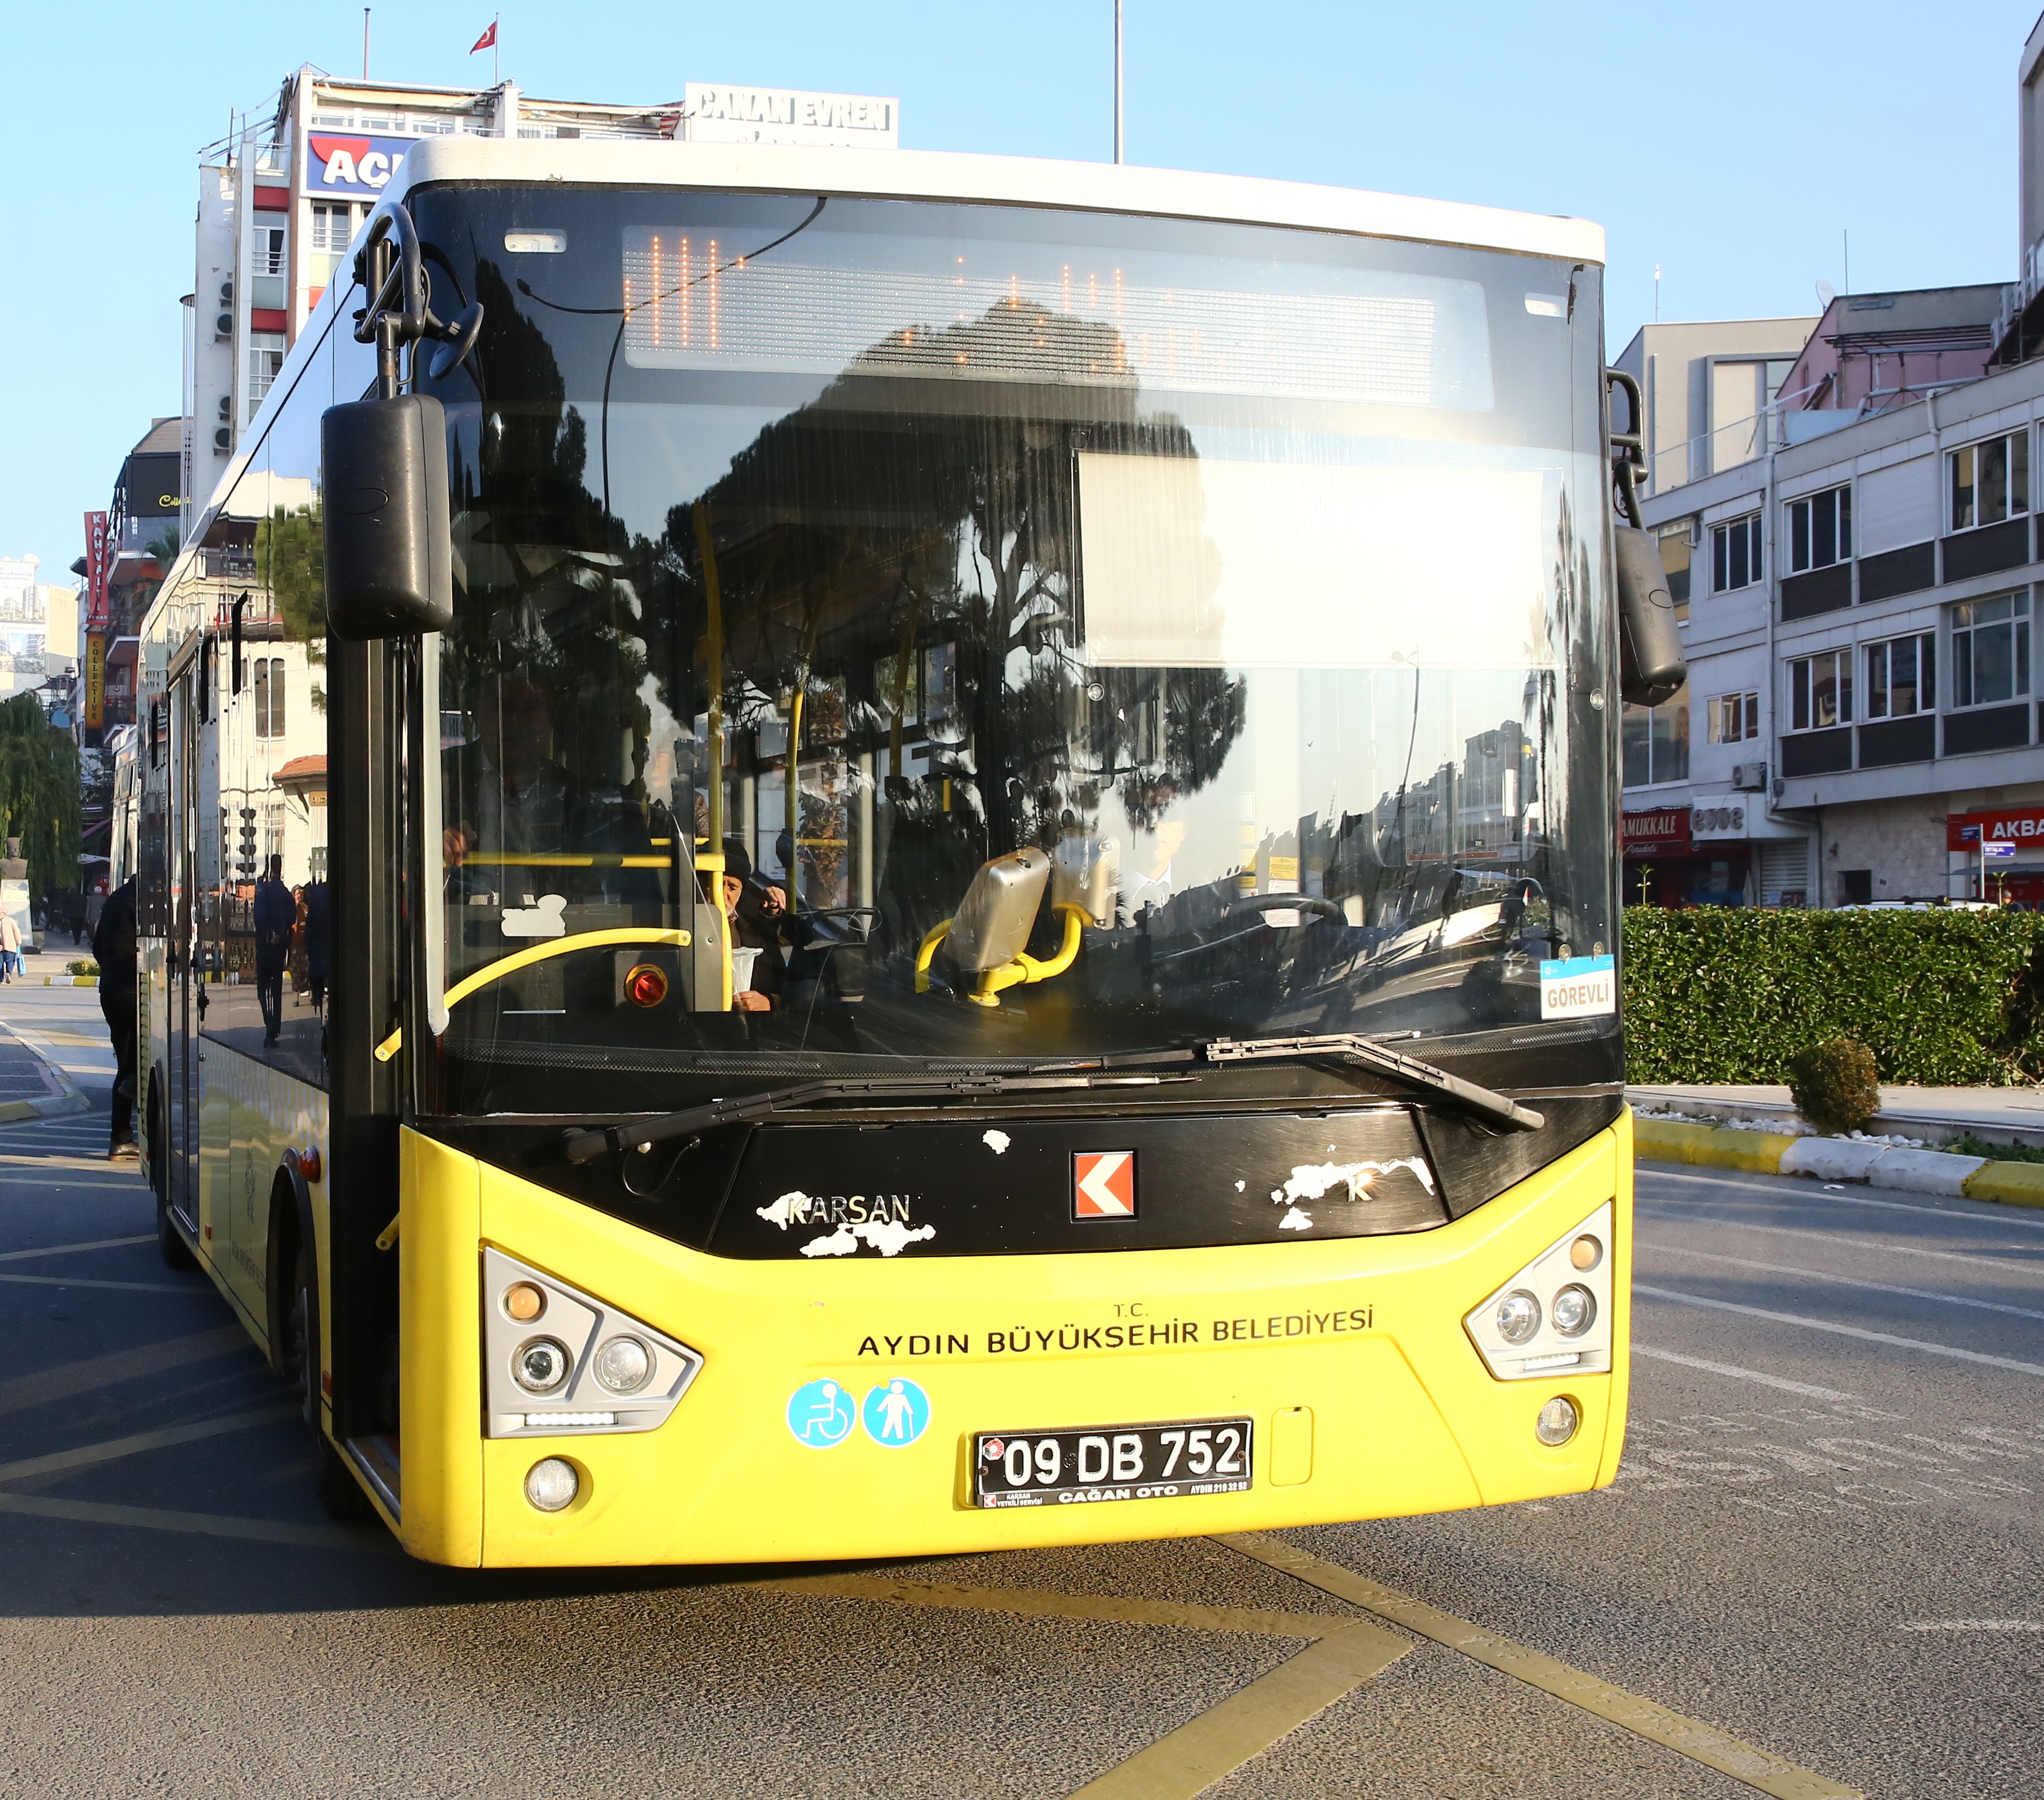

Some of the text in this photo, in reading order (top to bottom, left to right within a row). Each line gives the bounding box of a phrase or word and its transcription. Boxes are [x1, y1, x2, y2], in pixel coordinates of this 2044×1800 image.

[698, 89, 890, 131] CANAN EVREN
[92, 514, 104, 612] KAHVALTI
[1547, 977, 1609, 1008] GÖREVLİ
[789, 1194, 909, 1224] KARSAN
[1113, 1303, 1149, 1318] T.C.
[857, 1303, 1373, 1356] AYDIN BÜYÜKŞEHİR BELEDİYESİ
[1004, 1428, 1241, 1487] 09 DB 752
[1136, 1485, 1179, 1497] OTO
[1190, 1484, 1212, 1494] AYDIN
[1228, 1482, 1237, 1491] 32
[1238, 1481, 1247, 1490] 52
